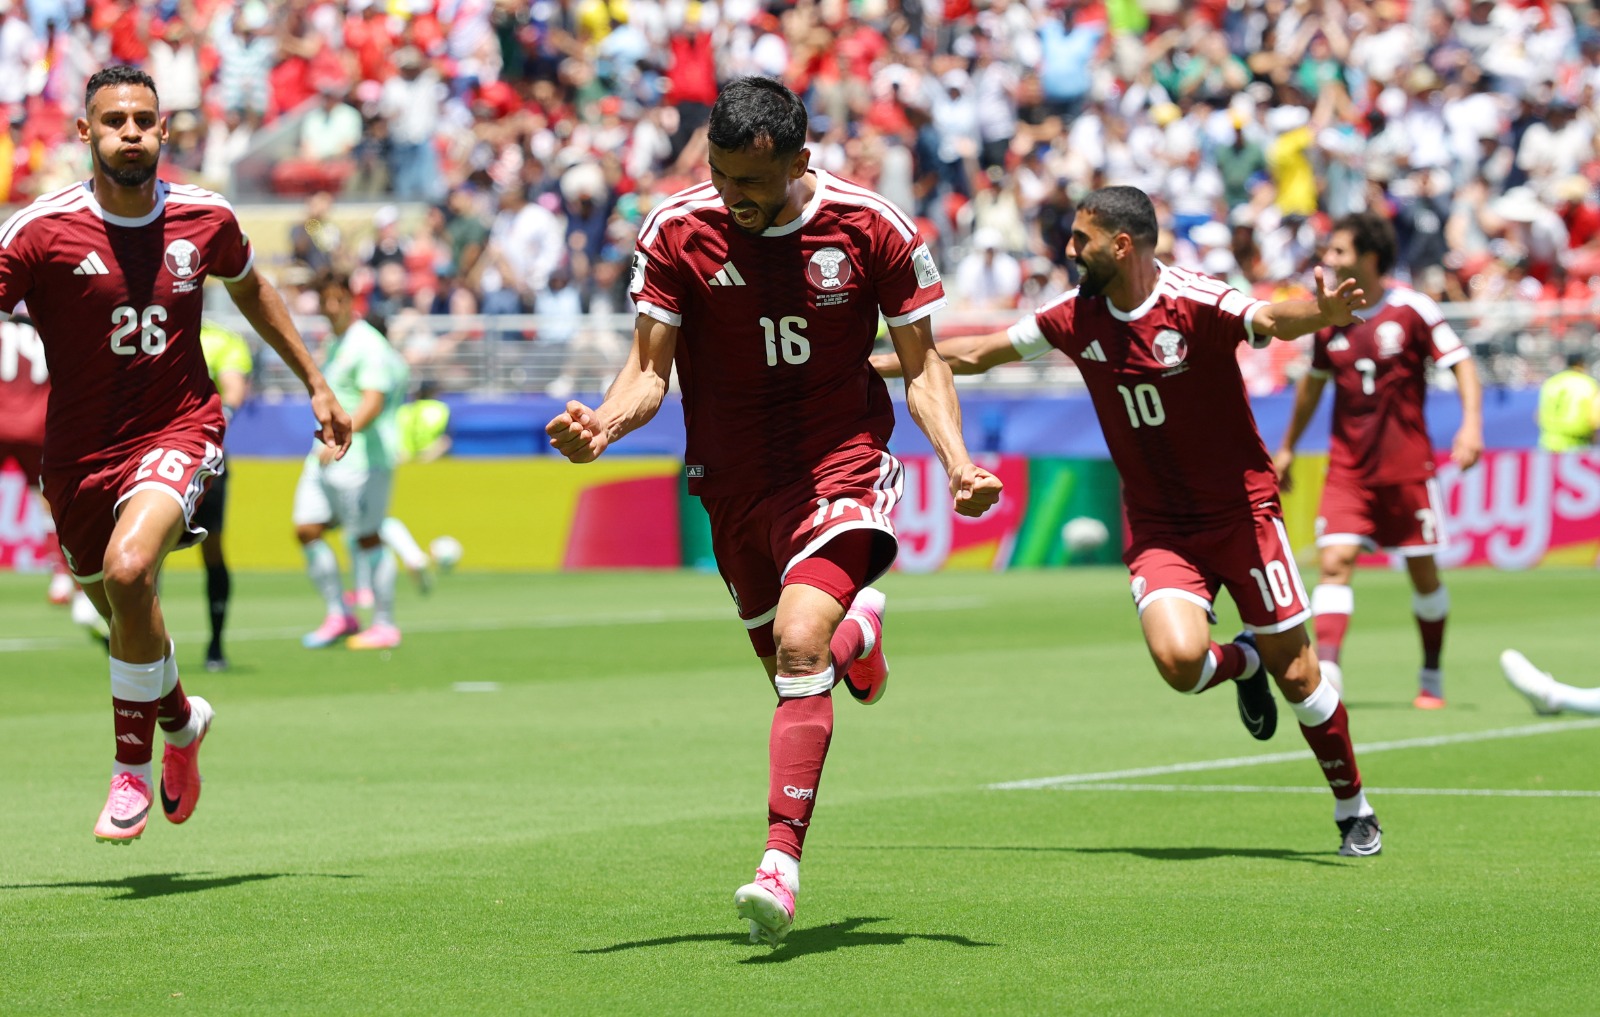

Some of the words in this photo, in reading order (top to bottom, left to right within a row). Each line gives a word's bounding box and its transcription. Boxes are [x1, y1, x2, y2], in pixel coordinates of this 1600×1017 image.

[822, 277, 841, 288] QFA
[111, 304, 168, 355] 26
[759, 315, 811, 367] 16
[1354, 357, 1377, 396] 7
[1117, 383, 1166, 429] 10
[137, 447, 192, 482] 26
[1250, 559, 1294, 613] 10
[782, 784, 813, 801] QFA
